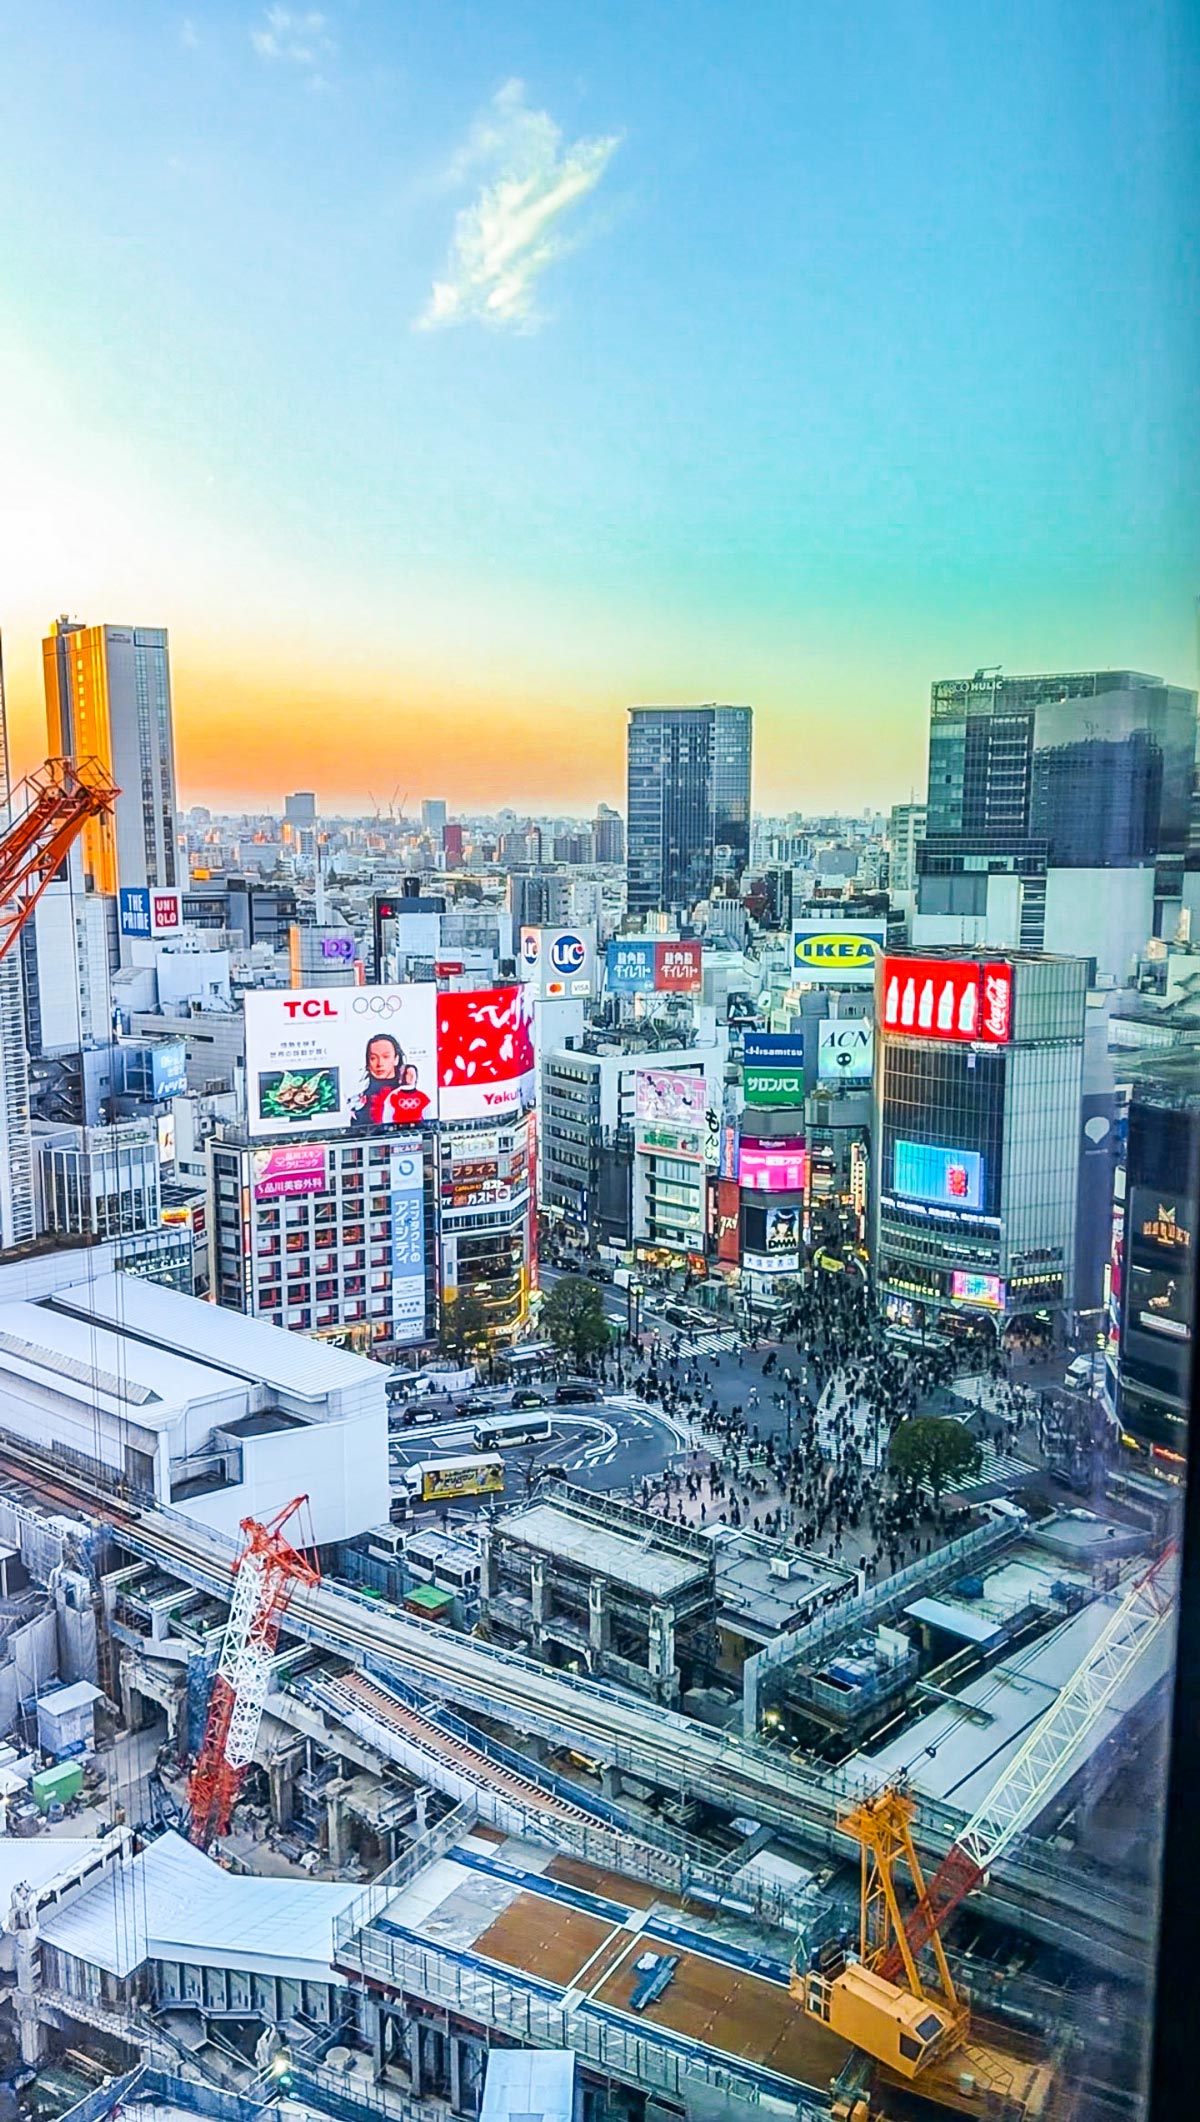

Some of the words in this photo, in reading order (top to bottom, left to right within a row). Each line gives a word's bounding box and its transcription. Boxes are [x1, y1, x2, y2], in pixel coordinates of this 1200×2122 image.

[127, 894, 143, 912] THE
[156, 899, 174, 911] UNI
[122, 912, 149, 930] PRIME
[157, 913, 176, 926] QLO
[321, 938, 355, 962] 109
[803, 944, 875, 957] IKEA
[574, 984, 589, 992] VISA
[284, 1000, 338, 1018] TCL
[822, 1031, 871, 1047] ACN
[746, 1046, 803, 1056] Hisamitsu
[747, 1077, 799, 1091] サロンパス
[482, 1179, 504, 1190] ガスト
[467, 1192, 494, 1205] ガスト
[395, 1200, 409, 1264] アイシティ
[410, 1200, 421, 1263] コンタクトの
[768, 1239, 798, 1249] DMM
[160, 1257, 190, 1268] CITY
[888, 1277, 941, 1297] STARBUCKS
[1010, 1273, 1062, 1288] STARBUCKS
